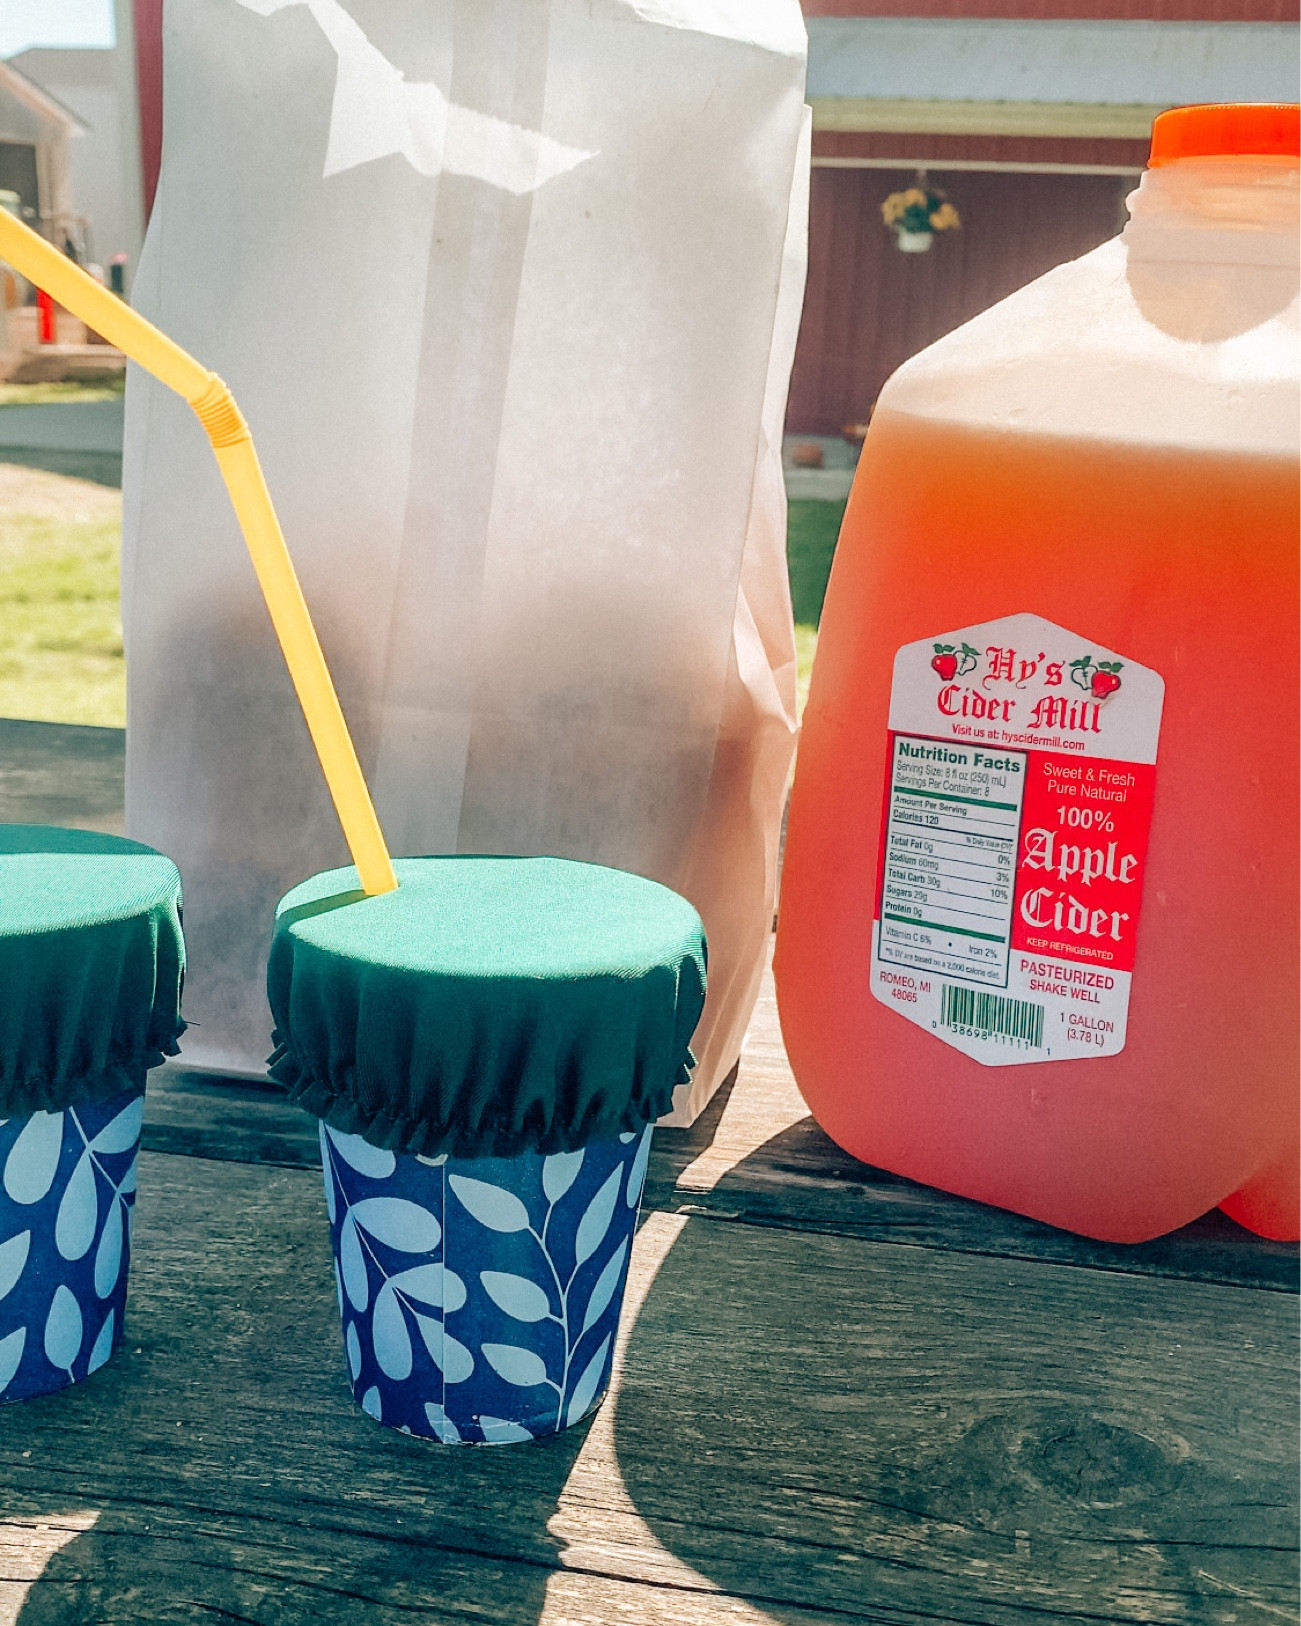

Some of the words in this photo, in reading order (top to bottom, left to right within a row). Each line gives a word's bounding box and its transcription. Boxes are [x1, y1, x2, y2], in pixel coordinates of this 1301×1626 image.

[982, 647, 1065, 690] Hy's
[937, 685, 1016, 722] Cider
[1027, 696, 1103, 733] Mill
[952, 724, 972, 736] Visit
[974, 728, 985, 738] us
[988, 729, 999, 740] at:
[1002, 731, 1085, 751] hyscidermill.com
[899, 742, 967, 765] Nutrition
[974, 753, 1020, 773] Facts
[897, 760, 923, 775] Serving
[925, 765, 943, 776] Size:
[945, 767, 950, 779] 8
[958, 771, 968, 780] oz
[991, 776, 1007, 788] mL)
[1043, 762, 1082, 780] Sweet
[1086, 768, 1095, 781] &
[1099, 769, 1135, 786] Fresh
[896, 772, 927, 788] Servings
[928, 778, 941, 788] Per
[942, 780, 981, 796] Container:
[984, 786, 990, 797] 8
[1047, 779, 1077, 795] Pure
[1080, 784, 1127, 802] Natural
[894, 795, 923, 807] Amount
[925, 799, 937, 809] Per
[940, 801, 967, 816] Serving
[893, 809, 923, 823] Calories
[925, 815, 939, 825] 120
[1057, 805, 1114, 832] 100%
[891, 835, 908, 847] Total
[910, 839, 922, 849] Fat
[889, 852, 916, 866] Sodium
[998, 854, 1010, 865] 0%
[1022, 827, 1138, 887] Apple
[888, 868, 905, 880] Total
[908, 872, 925, 884] Carb
[996, 872, 1009, 882] 3%
[886, 885, 912, 898] Sugars
[991, 889, 1008, 899] 10%
[885, 901, 911, 914] Protein
[1020, 887, 1129, 942] Cider
[886, 926, 912, 940] Vitamin
[913, 933, 918, 942] C
[914, 953, 932, 964] based
[968, 944, 983, 956] Iron
[985, 948, 998, 959] 2%
[1026, 936, 1048, 947] KEEP
[1050, 941, 1113, 961] REFRIGERATED
[880, 971, 917, 991] ROMEO,
[920, 980, 931, 992] MI
[1020, 959, 1114, 990] PASTEURIZED
[891, 988, 917, 1002] 48065
[1030, 979, 1067, 997] SHAKE
[1070, 987, 1100, 1004] WELL
[952, 1022, 988, 1040] 38698
[1060, 1013, 1064, 1022] 1
[1069, 1014, 1114, 1032] GALLON
[1067, 1028, 1092, 1043] (3.78
[1095, 1034, 1105, 1048] L)
